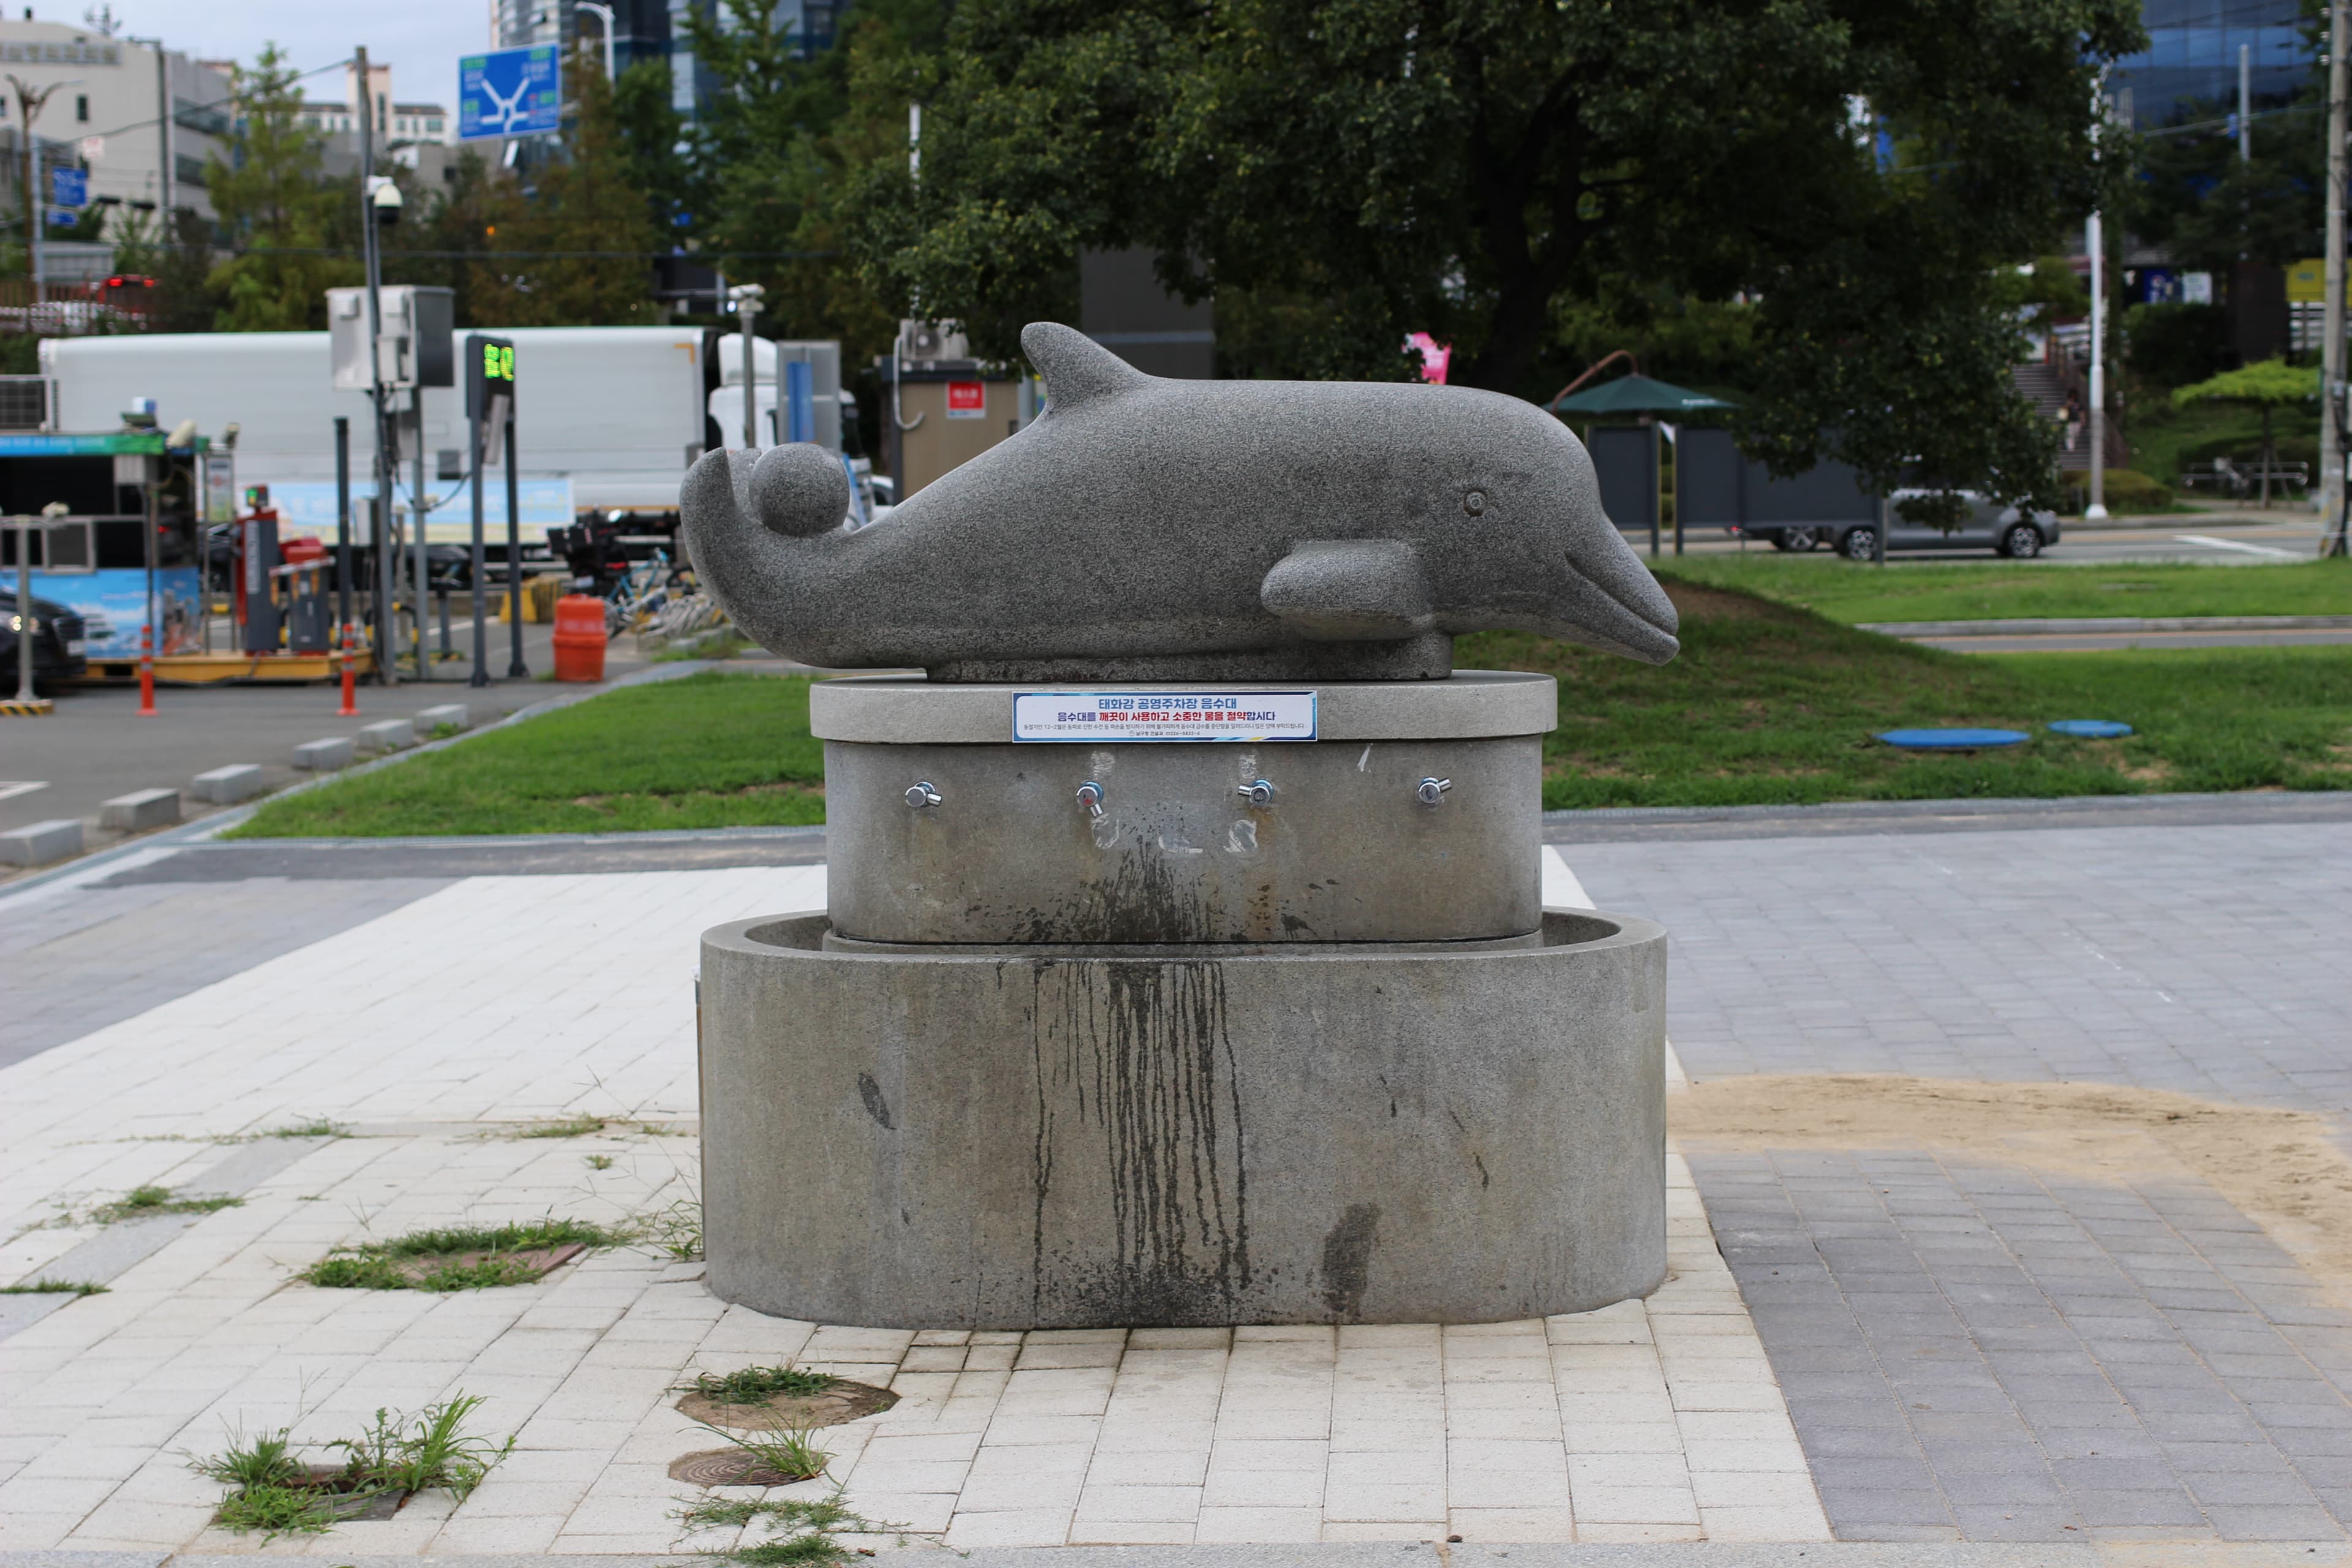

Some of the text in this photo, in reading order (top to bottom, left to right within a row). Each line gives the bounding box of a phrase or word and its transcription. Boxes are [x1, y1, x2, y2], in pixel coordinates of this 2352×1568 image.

[1099, 698, 1237, 709] 태화강 공영주차장 음수대
[1058, 711, 1276, 722] 음수대를 깨끗이 사용하고 소중한 물을 절약합시다
